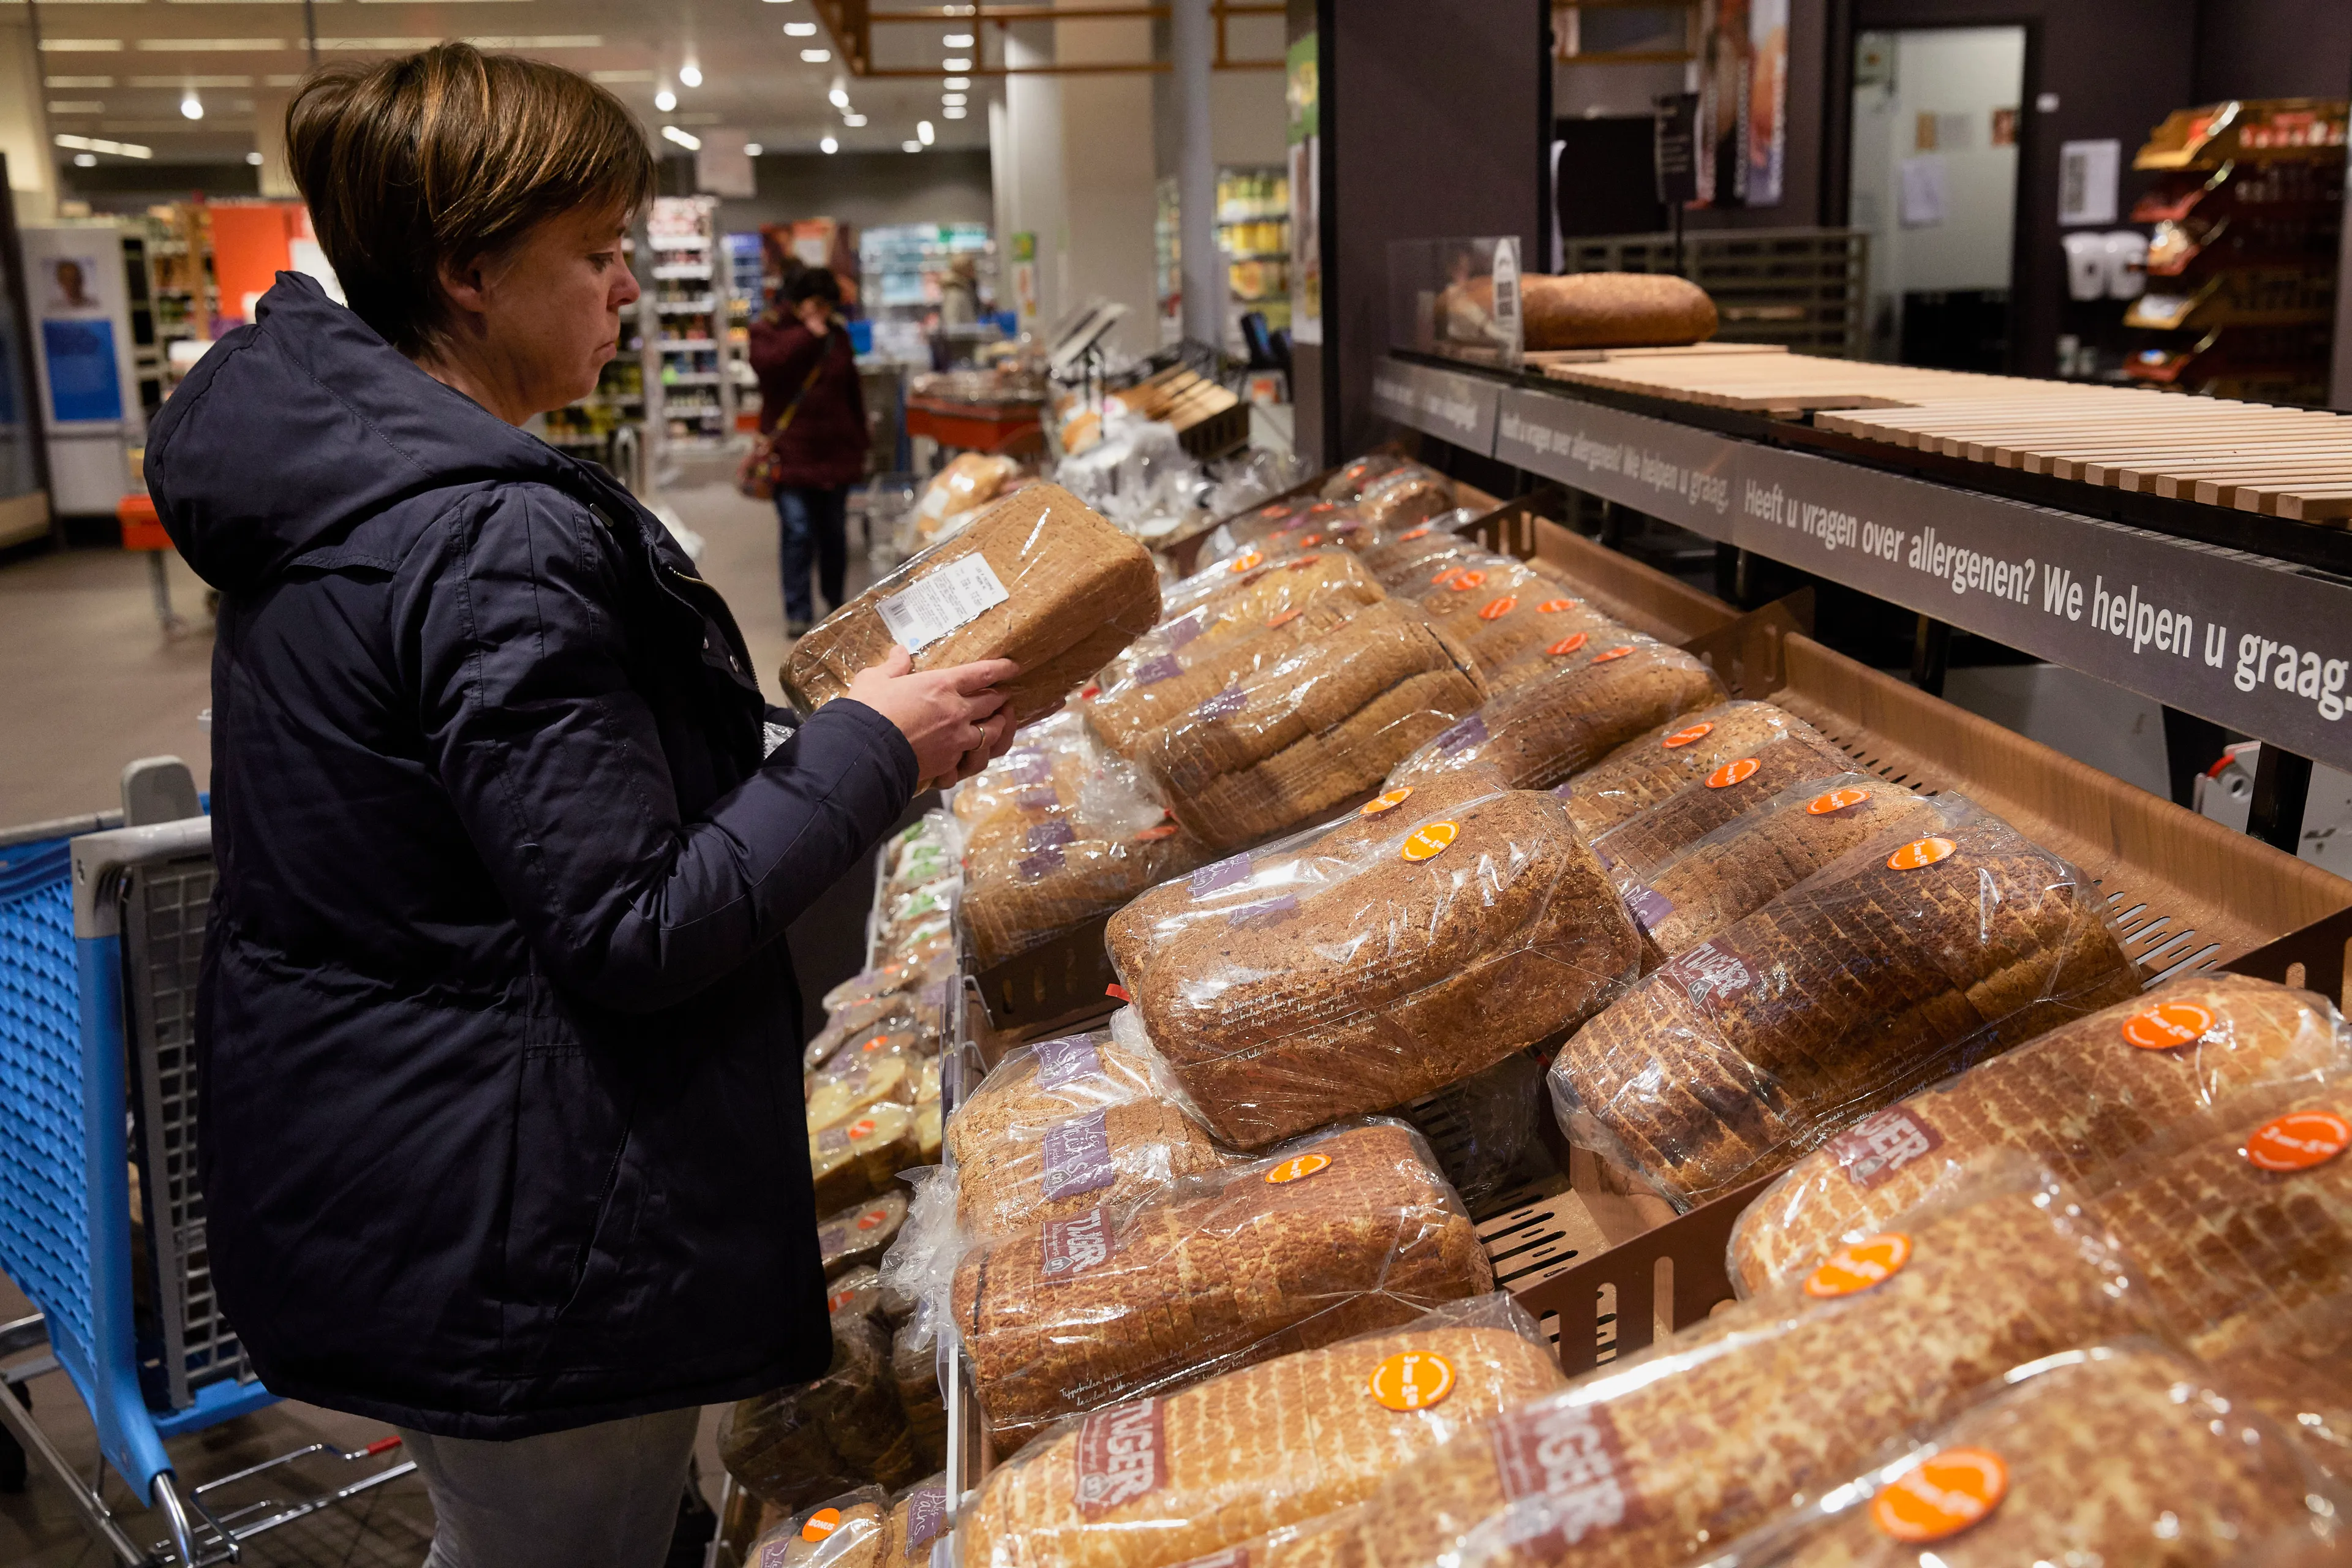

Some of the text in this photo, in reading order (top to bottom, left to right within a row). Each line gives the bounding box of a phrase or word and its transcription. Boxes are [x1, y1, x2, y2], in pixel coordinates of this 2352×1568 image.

[1744, 478, 2352, 722] Heeft u vragen over allergenen? We helpen u graag.
[1414, 830, 1425, 839] 3
[1419, 835, 1432, 845] voor
[808, 1518, 836, 1531] BONUS
